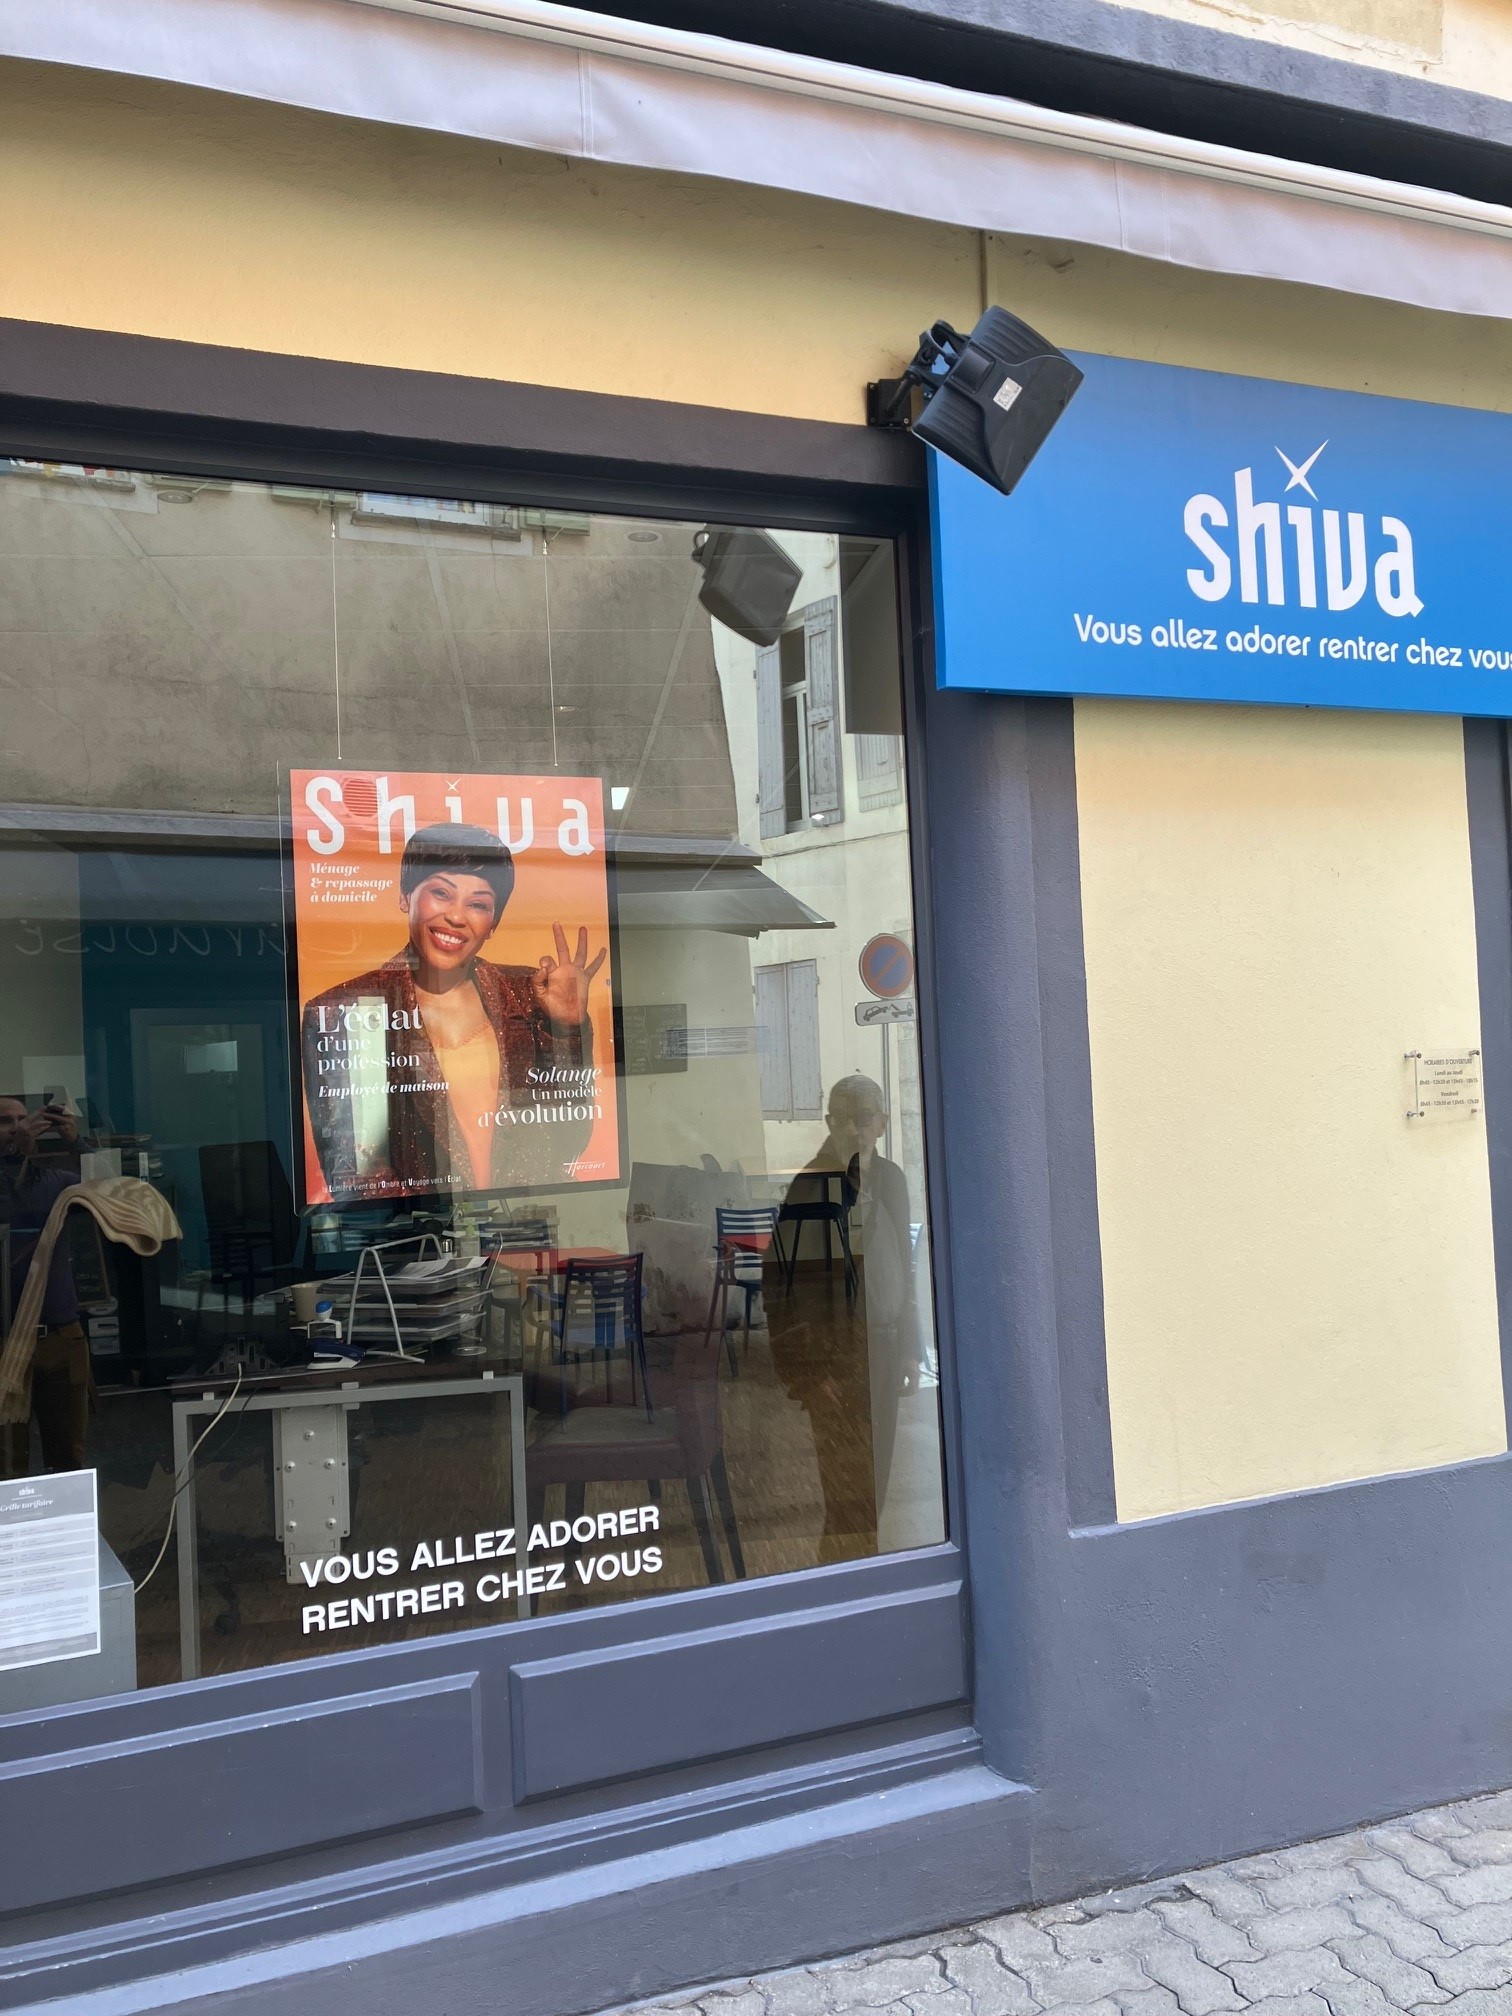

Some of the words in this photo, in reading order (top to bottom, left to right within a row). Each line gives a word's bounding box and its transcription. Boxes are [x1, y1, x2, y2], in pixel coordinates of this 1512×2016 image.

[1184, 465, 1425, 618] shiva
[1073, 613, 1143, 646] Vous
[1151, 618, 1218, 650] allez
[1225, 624, 1311, 656] adorer
[1319, 636, 1399, 662] rentrer
[1405, 637, 1463, 667] chez
[1468, 648, 1512, 671] vou
[310, 862, 360, 877] Ménage
[310, 877, 323, 888] &
[325, 879, 394, 891] repassage
[310, 891, 319, 903] à
[321, 890, 378, 903] domicile
[317, 1002, 423, 1034] L'éclat
[317, 1035, 372, 1053] d'une
[318, 1051, 420, 1075] profession
[525, 1066, 602, 1085] Solange
[319, 1082, 379, 1100] Employé
[380, 1082, 398, 1094] de
[400, 1079, 450, 1093] maison
[532, 1088, 551, 1101] Un
[553, 1085, 603, 1100] modèle
[478, 1101, 603, 1127] d'évolution
[299, 1548, 399, 1588] VOUS
[410, 1528, 517, 1571] ALLEZ
[526, 1505, 661, 1551] ADORER
[301, 1581, 465, 1634] RENTRER
[476, 1562, 567, 1602] CHEZ
[575, 1546, 664, 1585] VOUS
